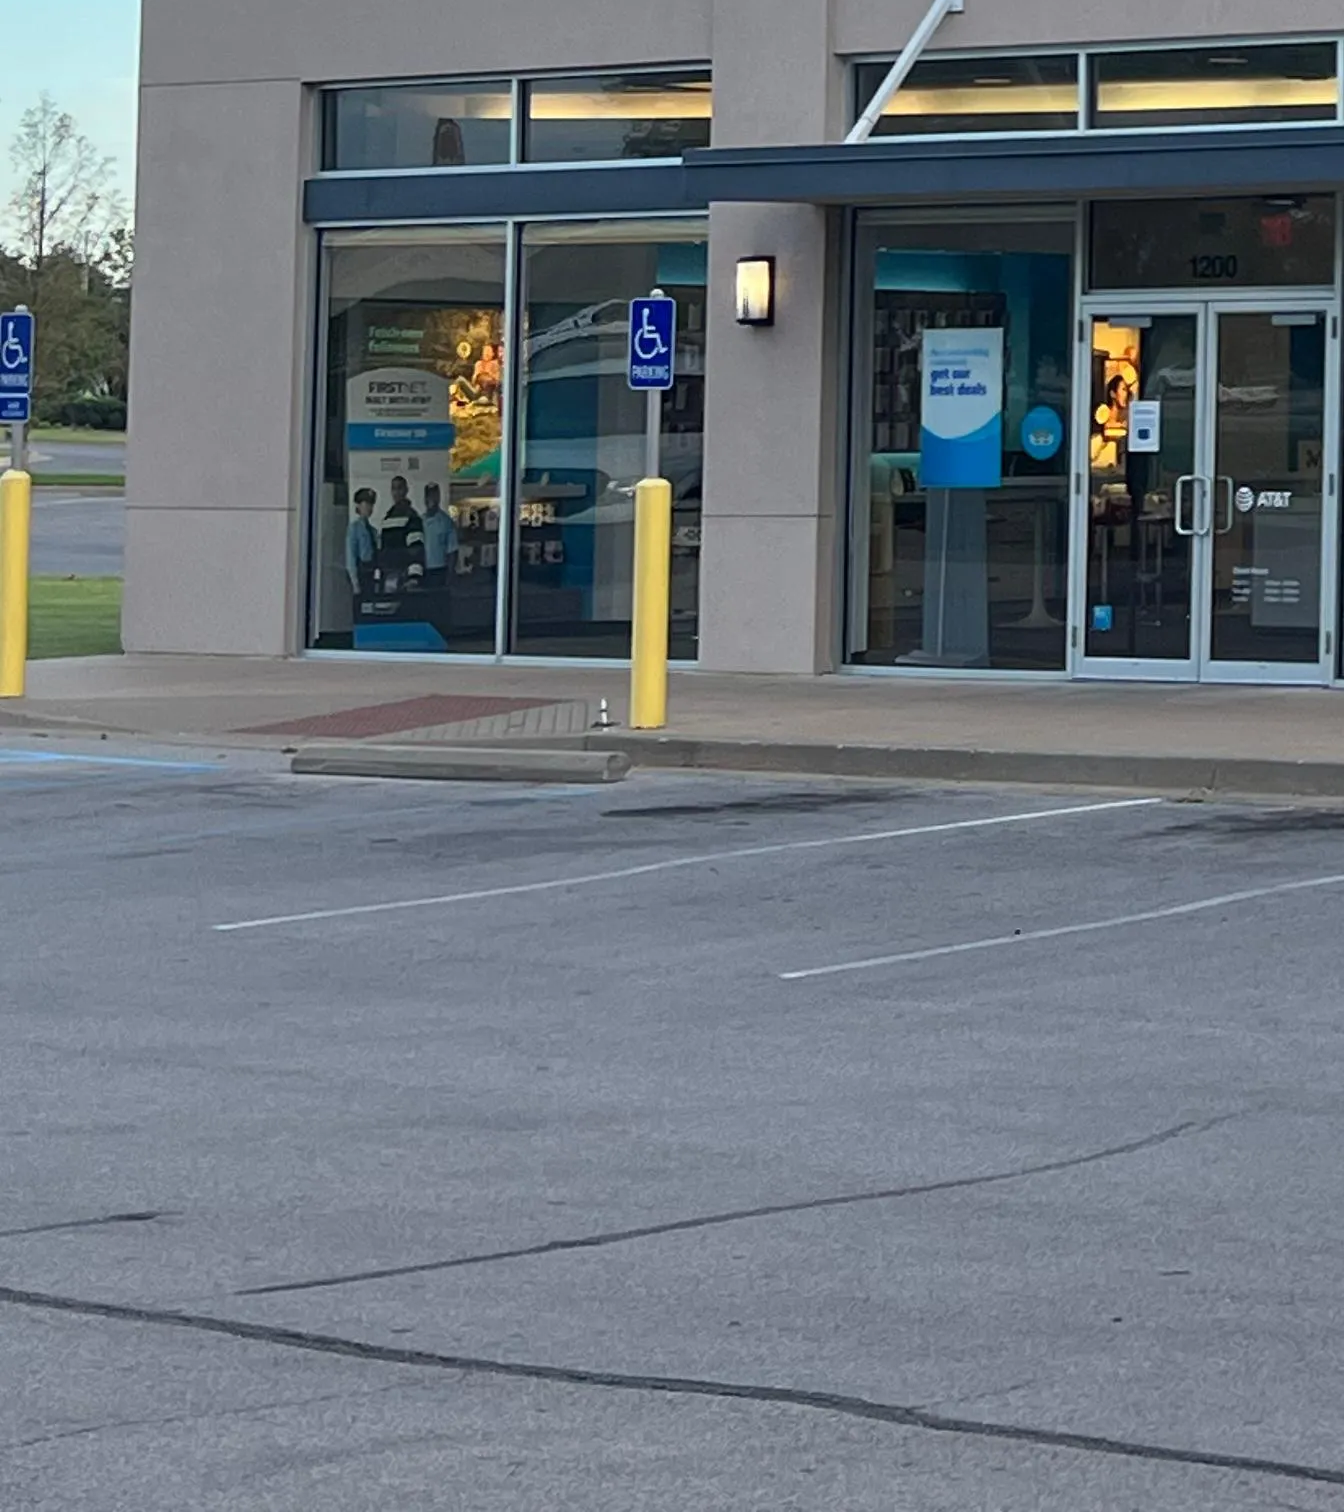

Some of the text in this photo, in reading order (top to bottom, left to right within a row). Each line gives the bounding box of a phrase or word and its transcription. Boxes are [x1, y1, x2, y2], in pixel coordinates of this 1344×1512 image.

[1190, 254, 1238, 279] 1200
[930, 368, 971, 384] get our
[930, 382, 988, 396] best deals
[1257, 491, 1293, 508] AT&T
